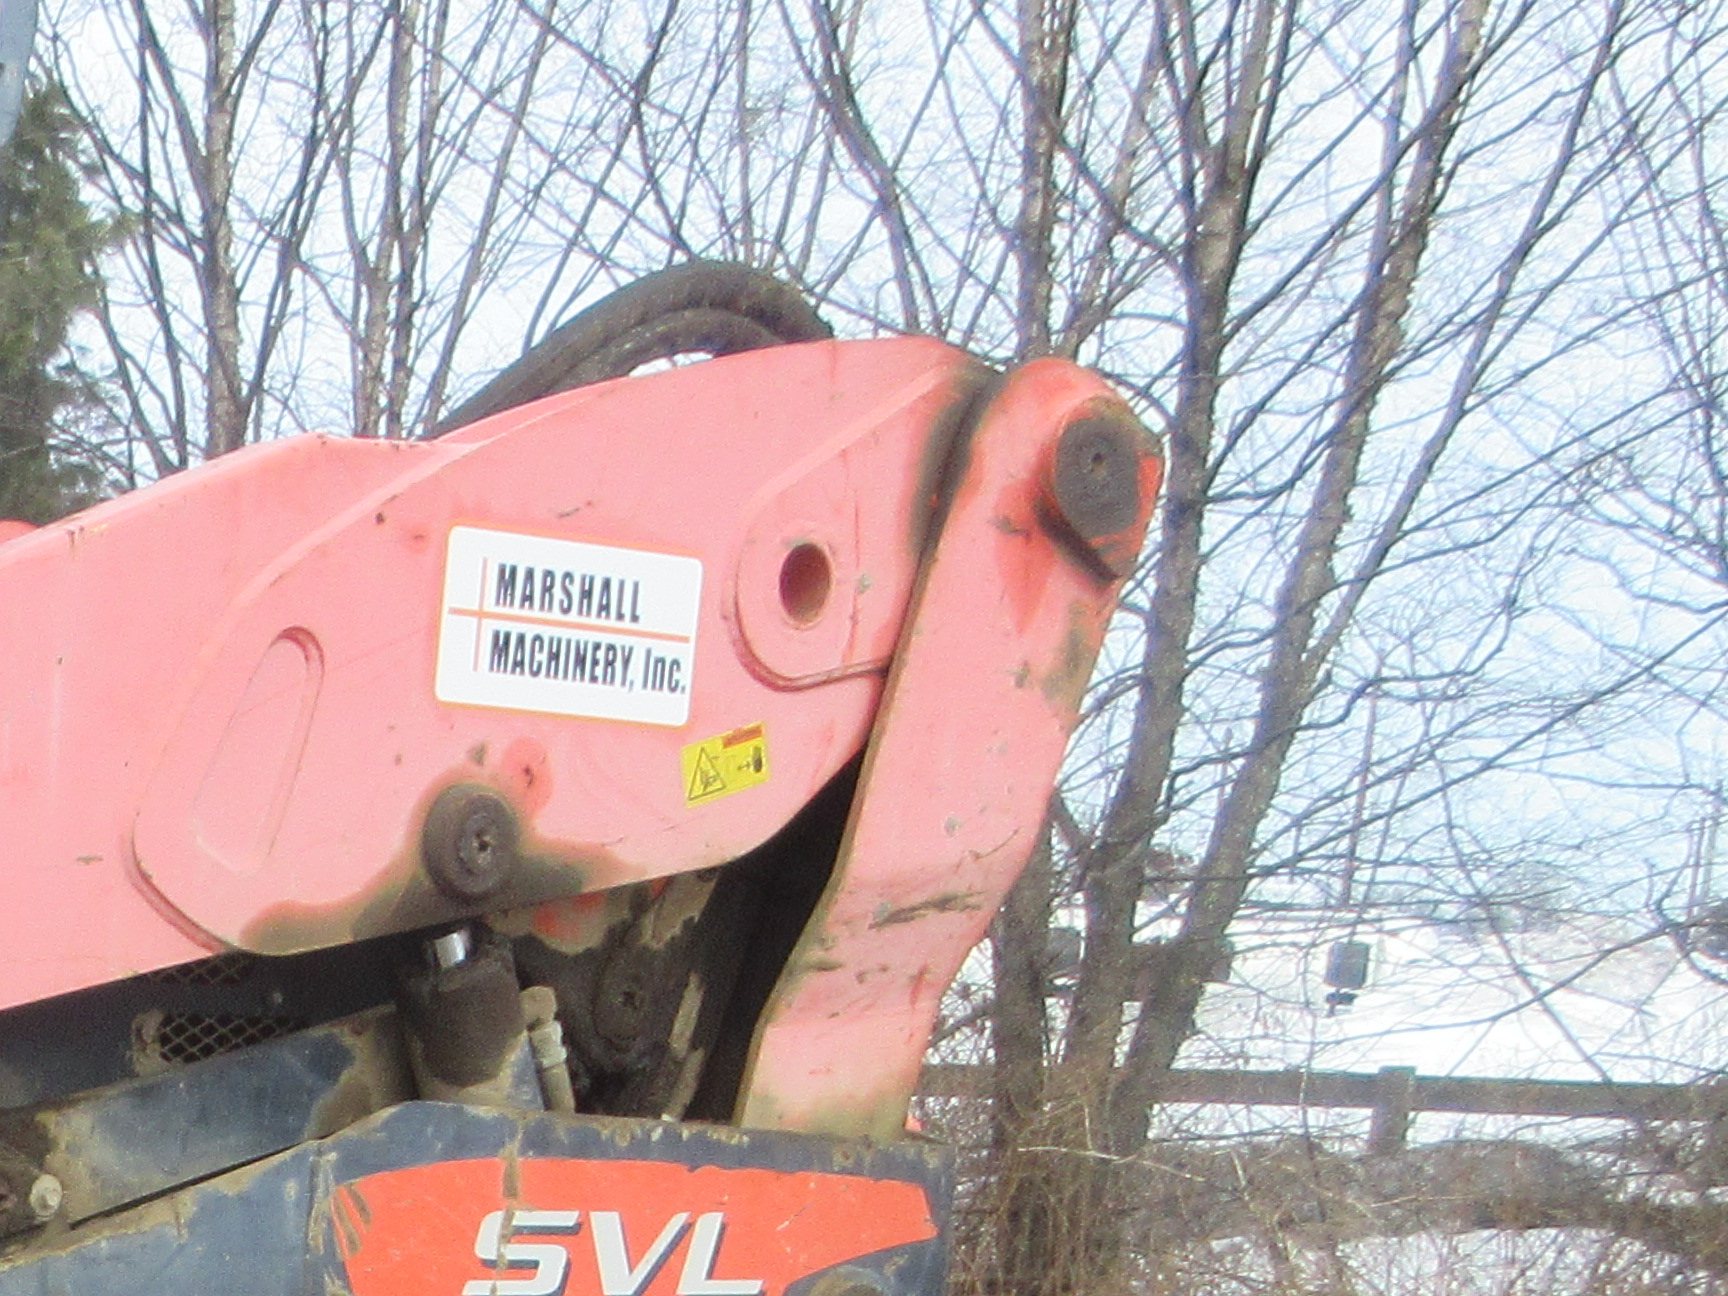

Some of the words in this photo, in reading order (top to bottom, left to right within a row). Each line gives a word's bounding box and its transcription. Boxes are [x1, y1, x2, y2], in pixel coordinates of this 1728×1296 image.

[495, 562, 640, 624] MARSHALL
[488, 629, 634, 692] MACHINERY,
[641, 647, 686, 694] Inc.
